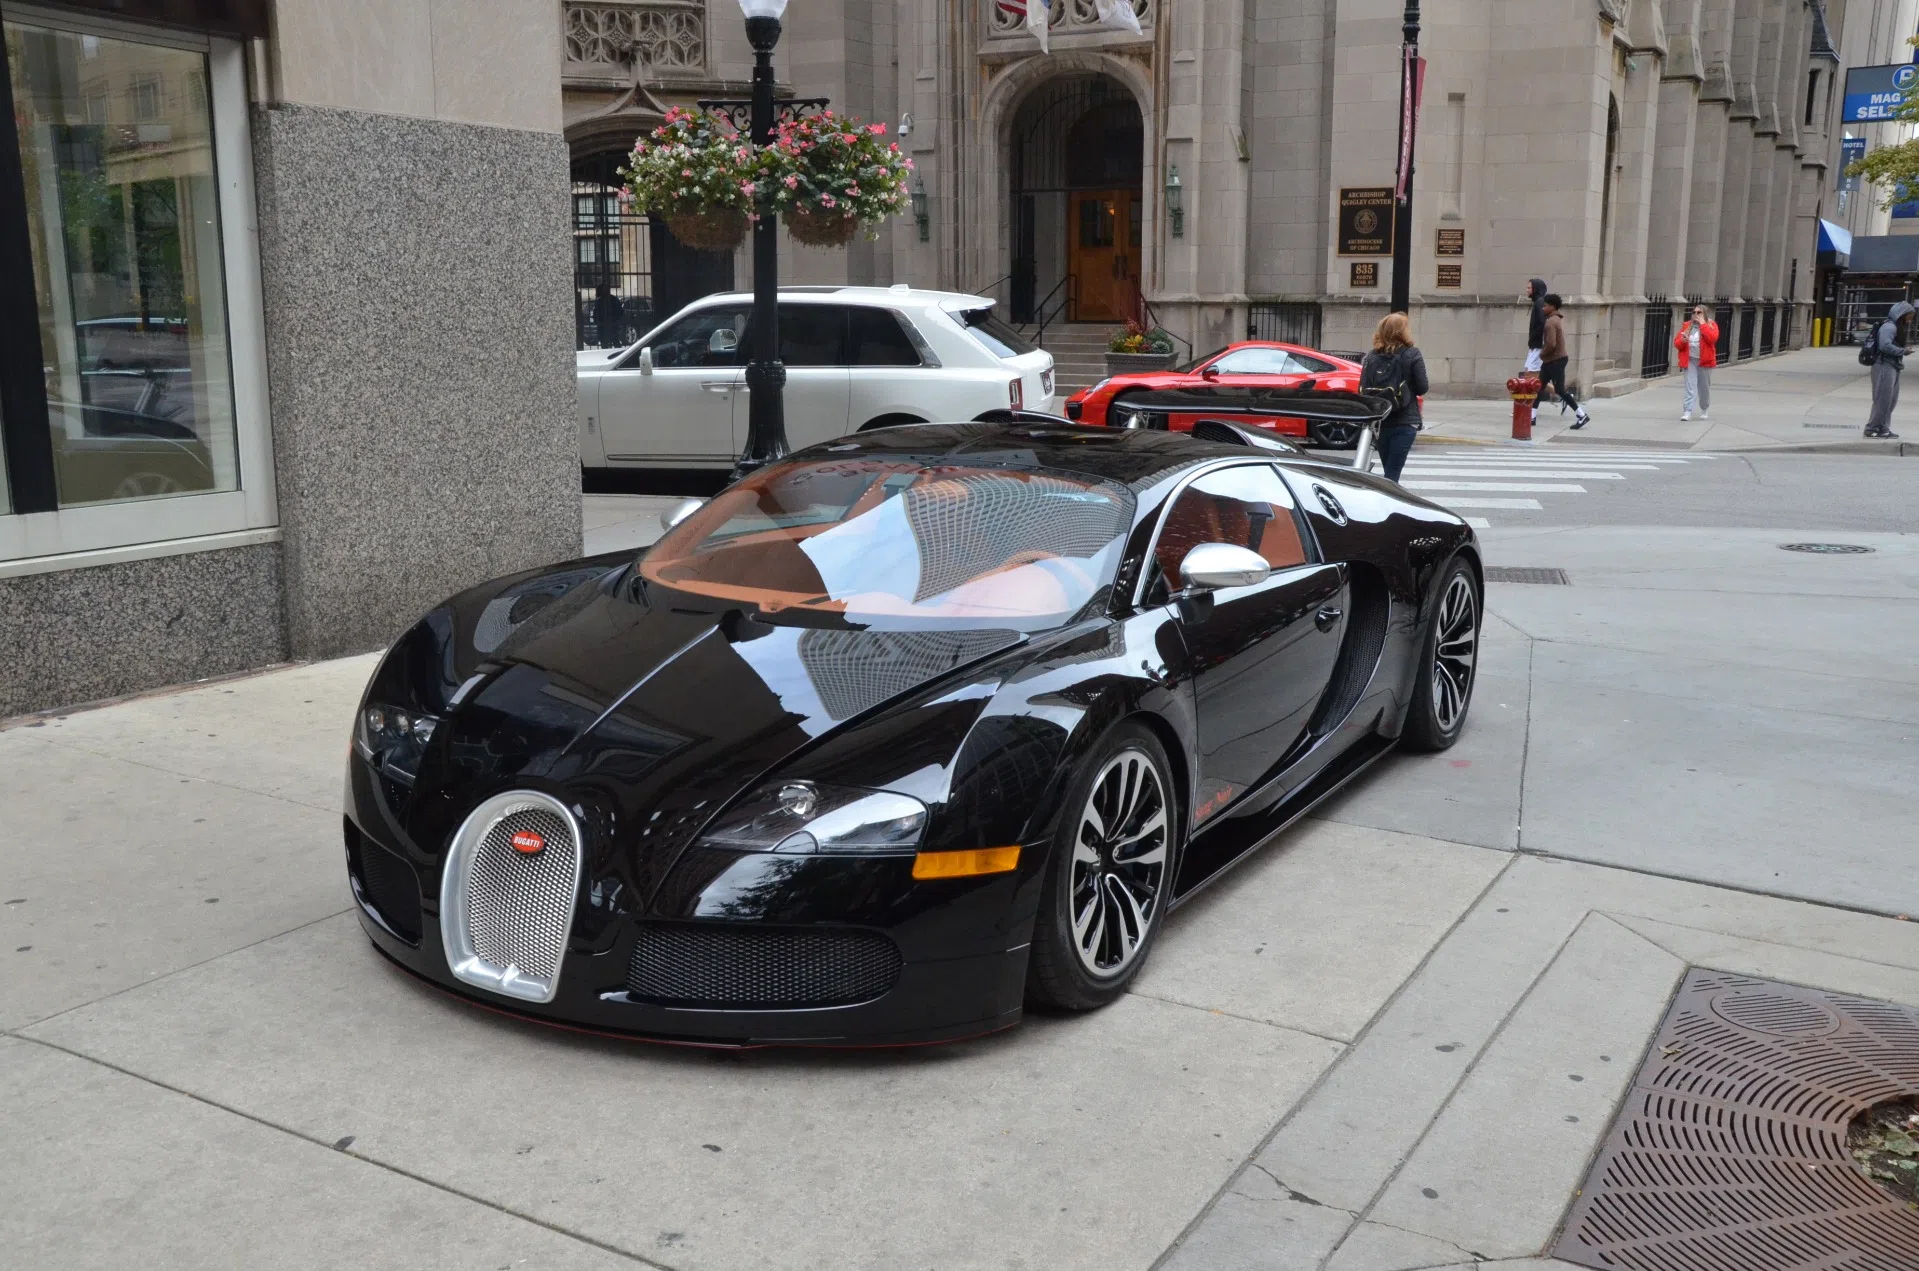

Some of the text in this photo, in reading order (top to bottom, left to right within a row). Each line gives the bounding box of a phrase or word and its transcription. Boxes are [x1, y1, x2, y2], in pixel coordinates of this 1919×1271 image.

[1870, 93, 1900, 104] MAG
[1355, 264, 1373, 275] 835
[513, 836, 540, 848] BUGATTI
